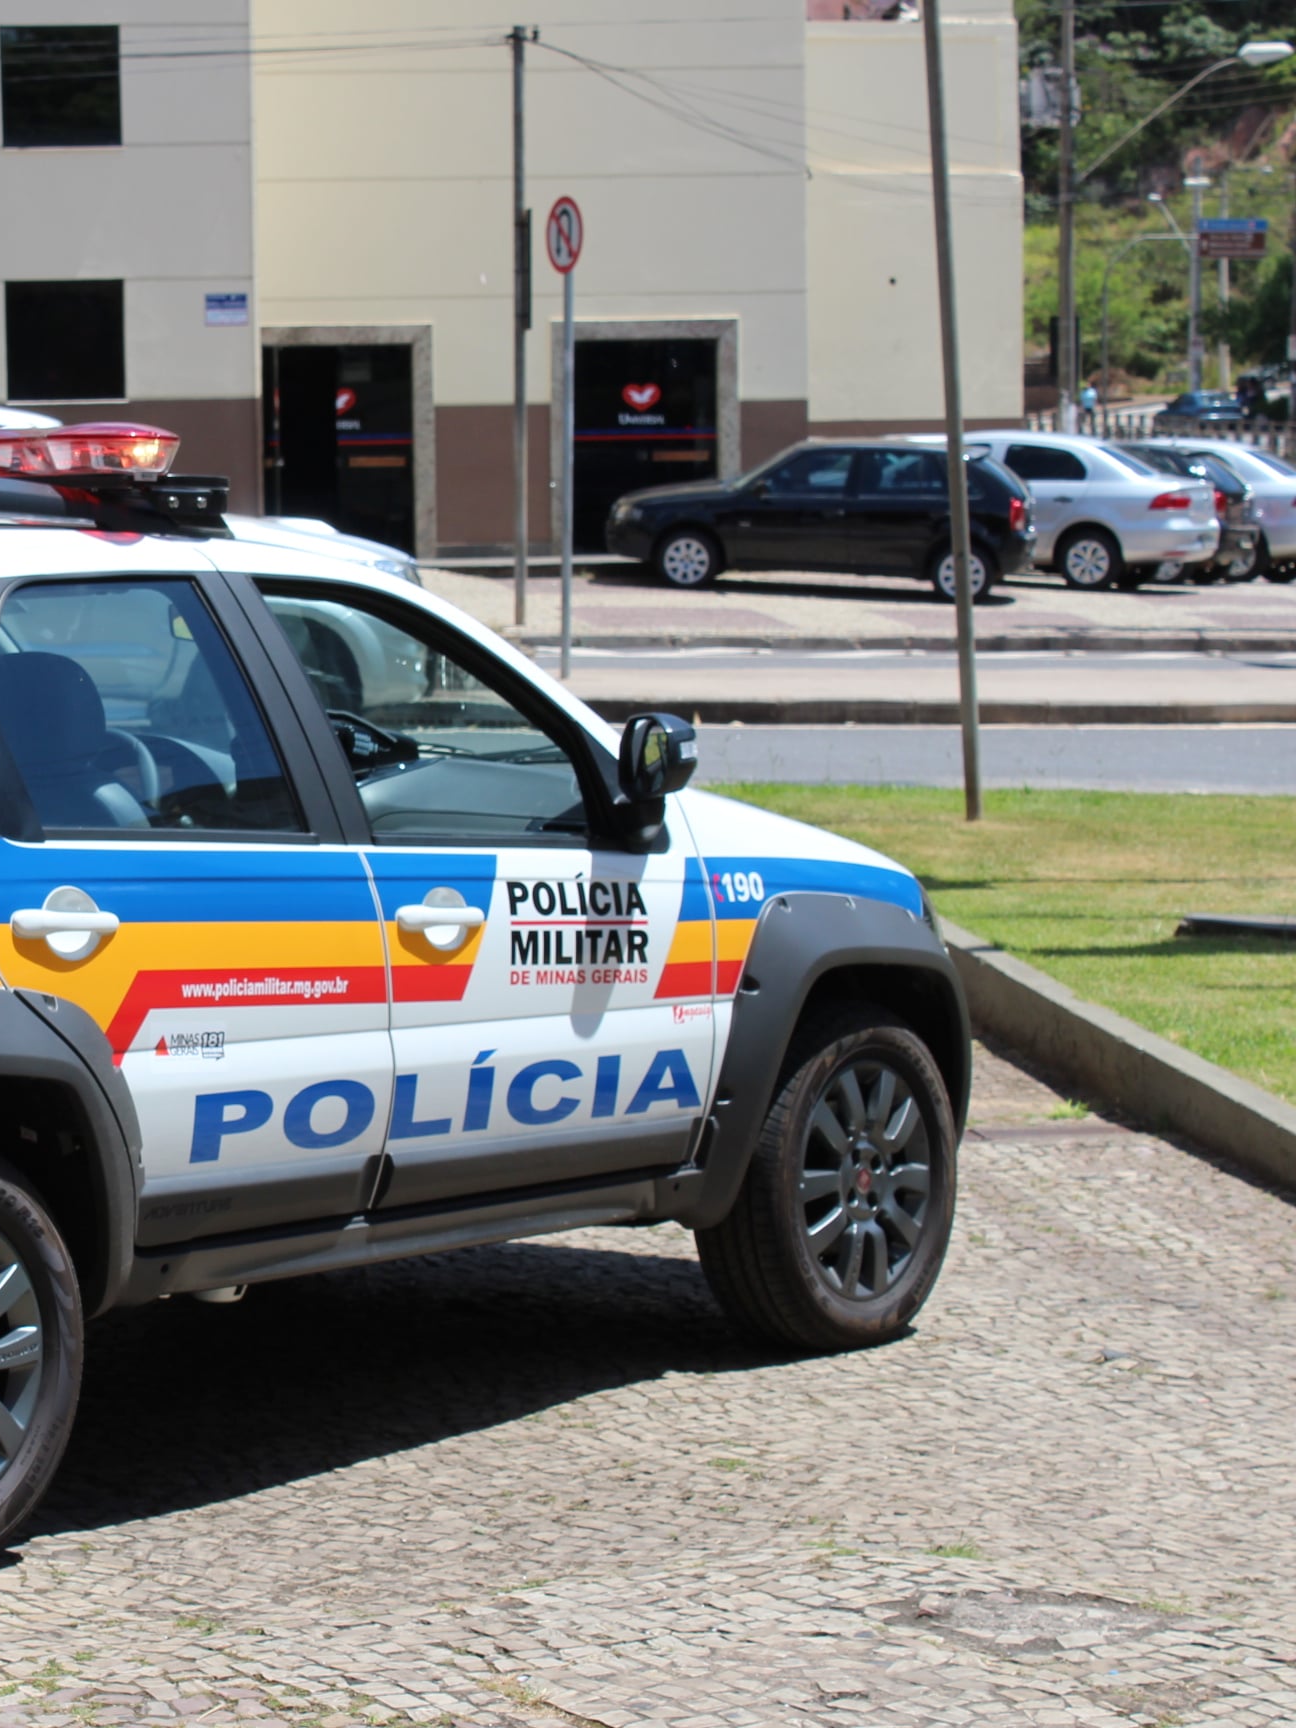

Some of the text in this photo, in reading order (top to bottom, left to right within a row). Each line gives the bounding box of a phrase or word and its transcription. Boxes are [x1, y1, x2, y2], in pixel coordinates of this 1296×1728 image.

[507, 872, 647, 916] POLÍCIA
[721, 871, 765, 902] 190
[510, 930, 649, 966] MILITAR
[181, 976, 349, 1001] www.policiamilitar.mg.gov.br
[510, 969, 648, 985] DE MINAS GERAIS
[170, 1032, 200, 1046] MINAS
[170, 1046, 200, 1057] GERAIS
[201, 1031, 225, 1047] 181
[189, 1048, 702, 1164] POLÍCIA
